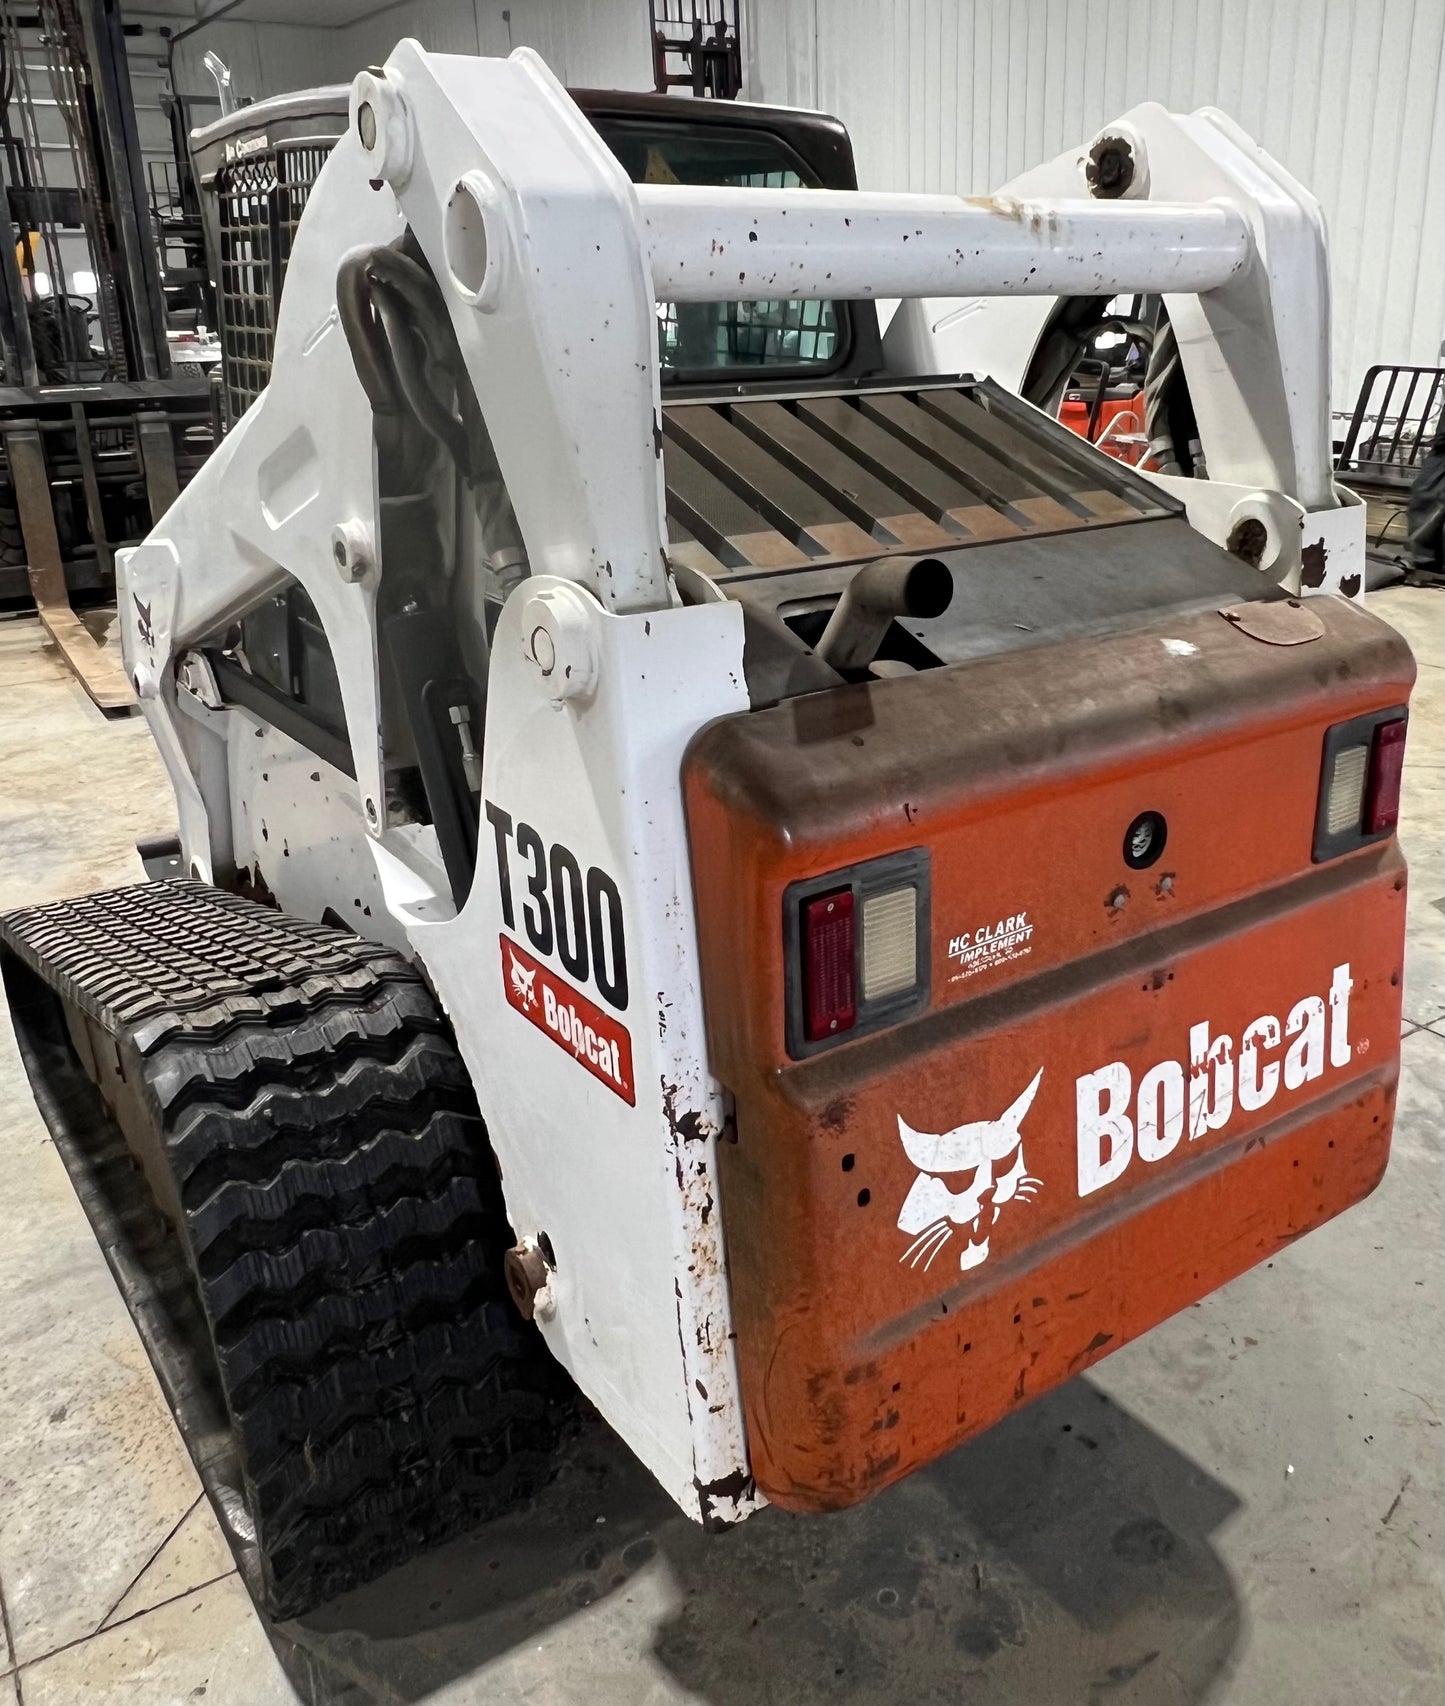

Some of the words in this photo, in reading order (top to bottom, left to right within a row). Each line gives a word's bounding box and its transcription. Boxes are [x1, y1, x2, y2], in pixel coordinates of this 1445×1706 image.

[485, 799, 629, 1012] T300
[948, 932, 970, 954] HC
[975, 912, 1027, 944] CLARK
[960, 928, 1033, 964] IMPLEMENT
[542, 983, 623, 1086] Bobcat
[1076, 962, 1354, 1198] Bobcat
